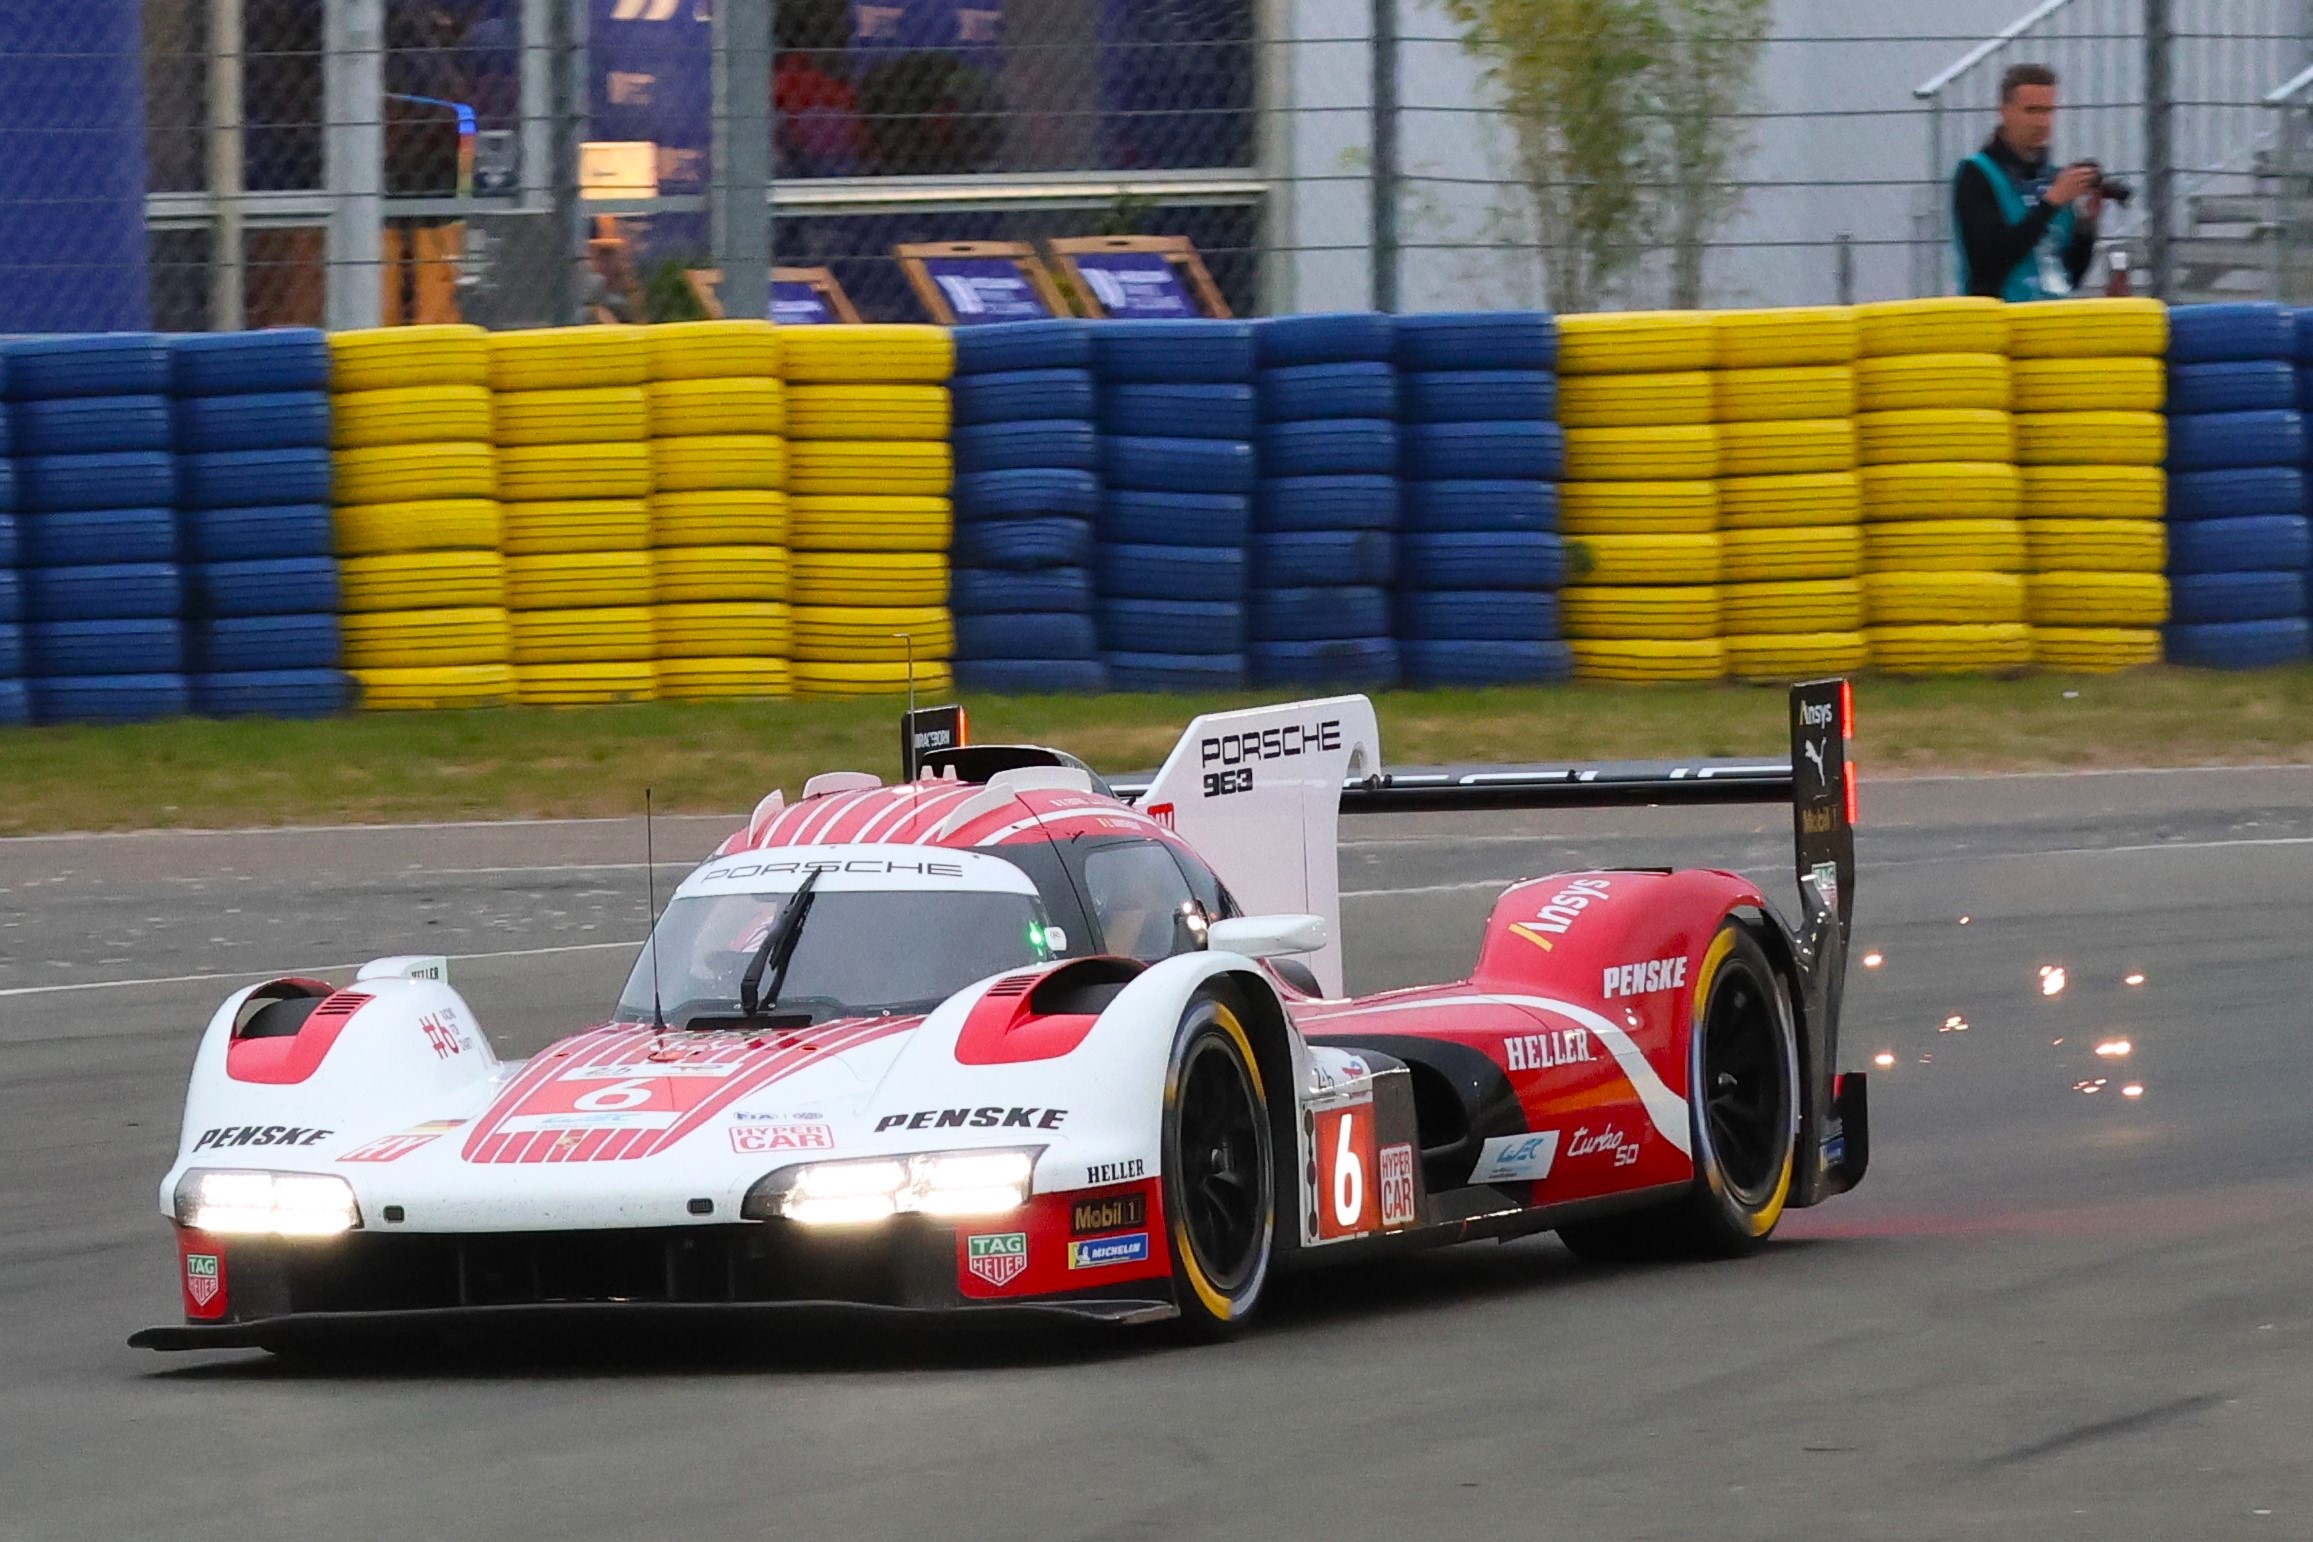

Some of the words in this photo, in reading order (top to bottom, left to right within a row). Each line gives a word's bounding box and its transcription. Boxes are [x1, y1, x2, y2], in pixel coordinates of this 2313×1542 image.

[1799, 699, 1833, 729] Ansys
[1201, 720, 1341, 769] PORSCHE
[1203, 767, 1253, 798] 963
[701, 860, 964, 884] PORSCHE
[1508, 878, 1611, 953] Ansys
[1603, 956, 1688, 999] PENSKE
[1504, 1028, 1592, 1071] HELLER
[573, 1077, 657, 1111] 6
[736, 1126, 822, 1137] HYPER
[874, 1106, 1069, 1133] PENSKE
[191, 1126, 335, 1154] PENSKE
[739, 1133, 825, 1150] CAR
[1567, 1122, 1624, 1157] turbo
[1334, 1113, 1363, 1227] 6
[1382, 1150, 1411, 1180] HYPER
[1614, 1143, 1640, 1167] 50
[1087, 1158, 1145, 1184] HELLER
[1383, 1176, 1412, 1220] CAR
[1075, 1201, 1122, 1231] Mobil
[1128, 1201, 1135, 1222] 1
[973, 1236, 1022, 1254] TAG
[1092, 1242, 1142, 1260] MICHELIN
[188, 1258, 215, 1275] TAG
[971, 1255, 1024, 1283] HEUER
